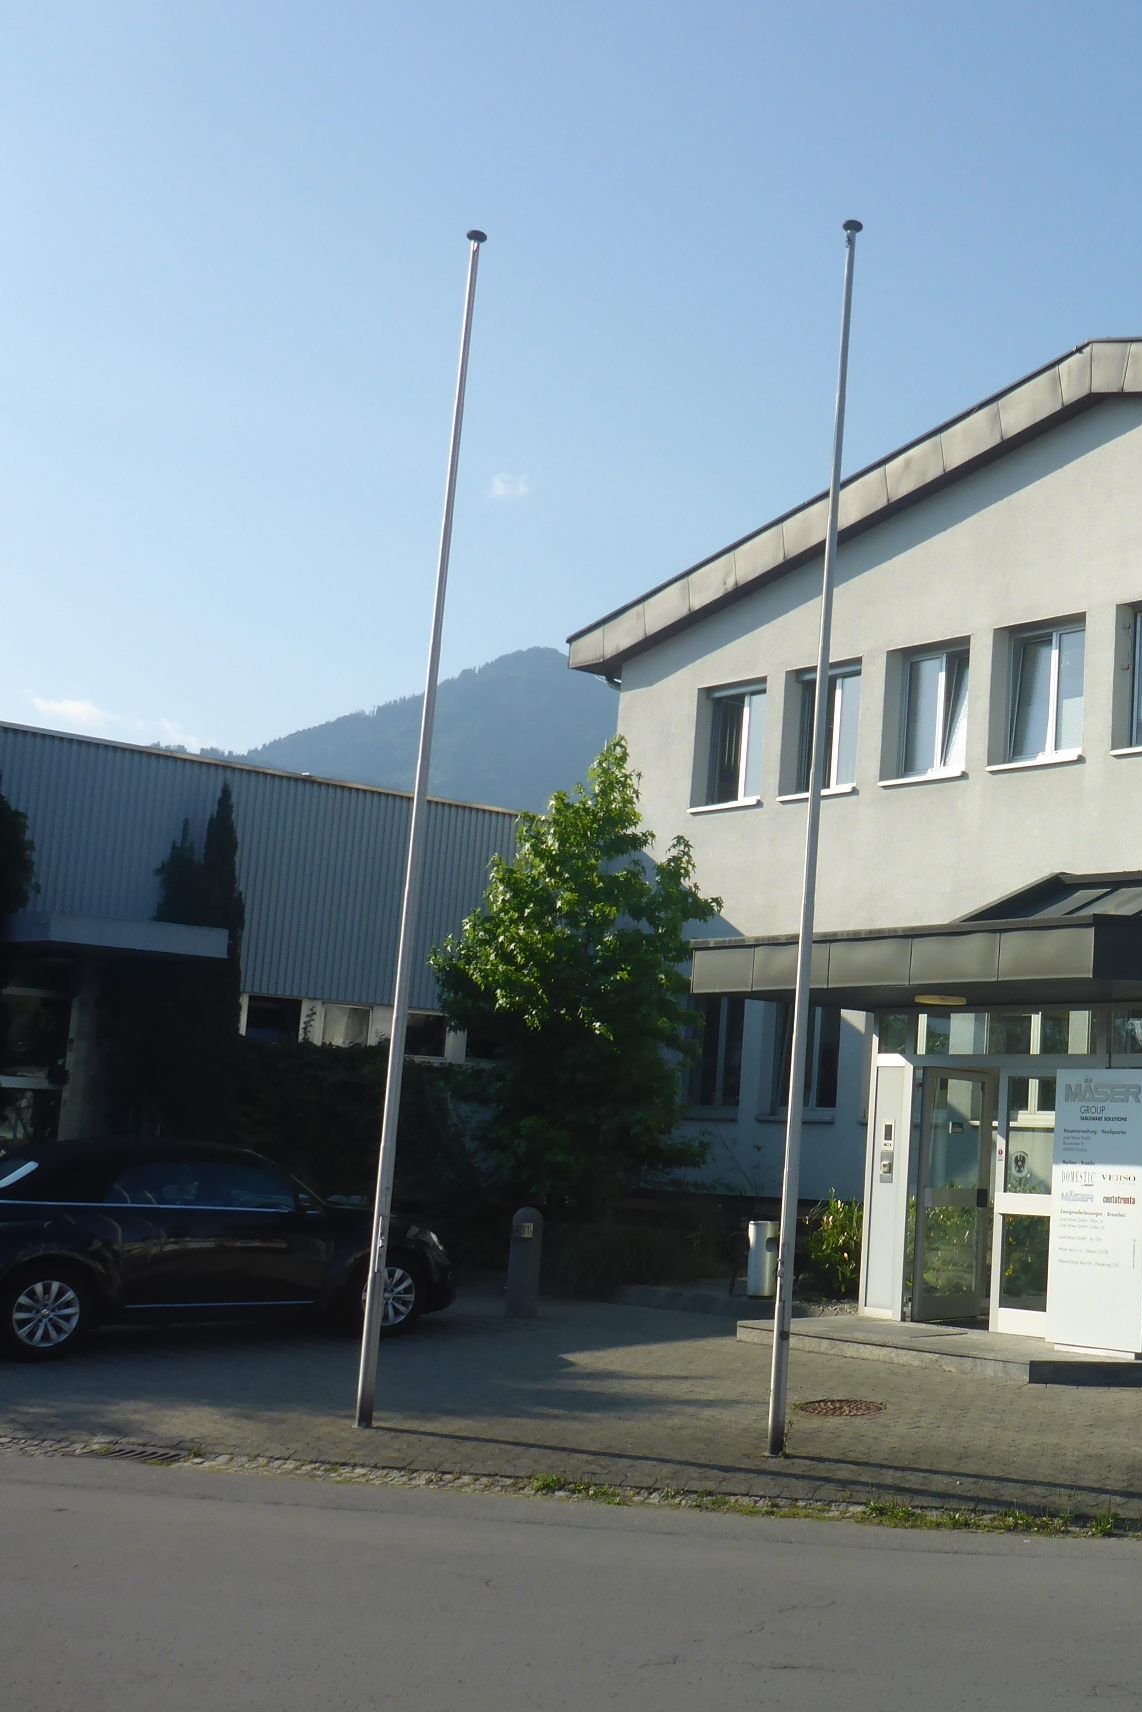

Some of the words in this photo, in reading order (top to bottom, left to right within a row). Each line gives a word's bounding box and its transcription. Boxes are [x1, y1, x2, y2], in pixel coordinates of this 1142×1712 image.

[1064, 1078, 1142, 1103] MÄSER
[1079, 1105, 1106, 1115] GROUP
[1061, 1170, 1096, 1184] DOMESTIC
[1060, 1190, 1095, 1203] MÄSER
